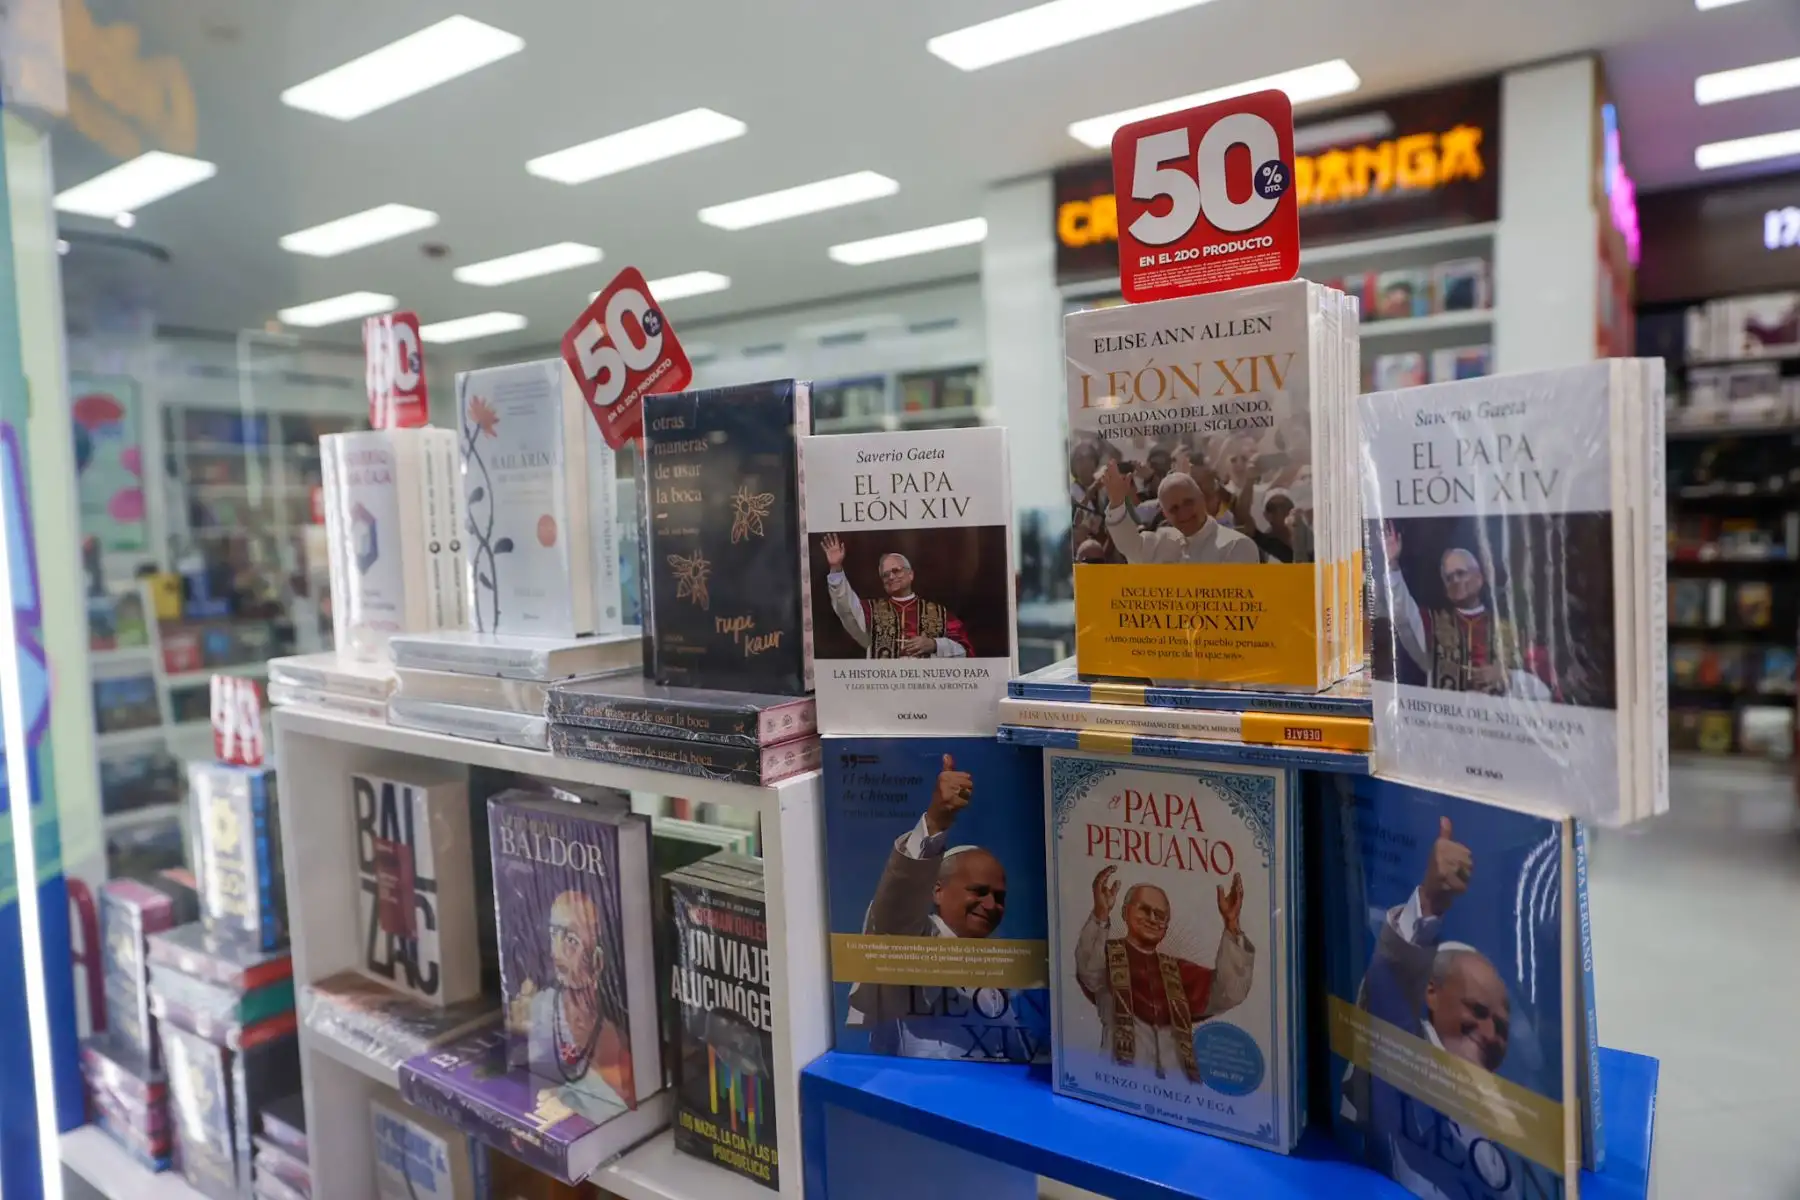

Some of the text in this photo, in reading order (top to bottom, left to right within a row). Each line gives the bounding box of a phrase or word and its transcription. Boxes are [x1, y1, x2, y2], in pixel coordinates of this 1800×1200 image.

[1127, 112, 1281, 246] 50
[1139, 236, 1274, 268] EN EL 2DO PRODUCTO
[573, 287, 664, 407] 50
[1093, 315, 1273, 355] ELISE ANN ALLEN
[607, 410, 618, 423] EN
[637, 357, 673, 395] PRODUCTO
[1080, 352, 1298, 410] LEÓN XIV
[652, 415, 685, 431] otras
[1097, 407, 1178, 426] CIUDADANO
[1180, 405, 1209, 419] DEL
[1097, 415, 1275, 441] MISIONERO DEL SIGLO XXI
[653, 438, 709, 455] maneras
[855, 447, 945, 464] Saverio Gaeta
[1412, 433, 1536, 470] EL PAPA
[654, 464, 702, 480] de usar
[854, 471, 955, 496] EL PAPA
[656, 487, 703, 504] la boca
[1396, 468, 1560, 506] LEÓN XIV
[839, 496, 972, 523] LEÓN XIV
[1110, 600, 1268, 613] ENTREVISTA OFICIAL DEL
[1120, 586, 1255, 600] INCLUYE LA PRIMERA
[715, 615, 756, 644] rupi
[1118, 610, 1260, 632] PAPA LEÓN XIV
[744, 630, 785, 658] kaur
[833, 668, 991, 679] LA HISTORIA DEL NUEVO PAPA
[675, 712, 686, 727] la
[686, 714, 711, 729] boca
[1406, 700, 1464, 719] HISTORIA
[1467, 707, 1490, 722] DEL
[1286, 728, 1321, 740] DEBATE
[689, 751, 713, 766] boca
[1123, 788, 1206, 833] PAPA
[500, 825, 606, 877] BALDOR
[1085, 823, 1235, 877] PERUANO
[1576, 844, 1594, 973] PAPA PERUANO
[688, 928, 769, 987] UN VIAJE
[960, 1023, 1049, 1063] XIV
[1094, 1071, 1138, 1091] RENZO
[1196, 1095, 1237, 1116] VEGA
[1156, 1107, 1183, 1122] Planeta
